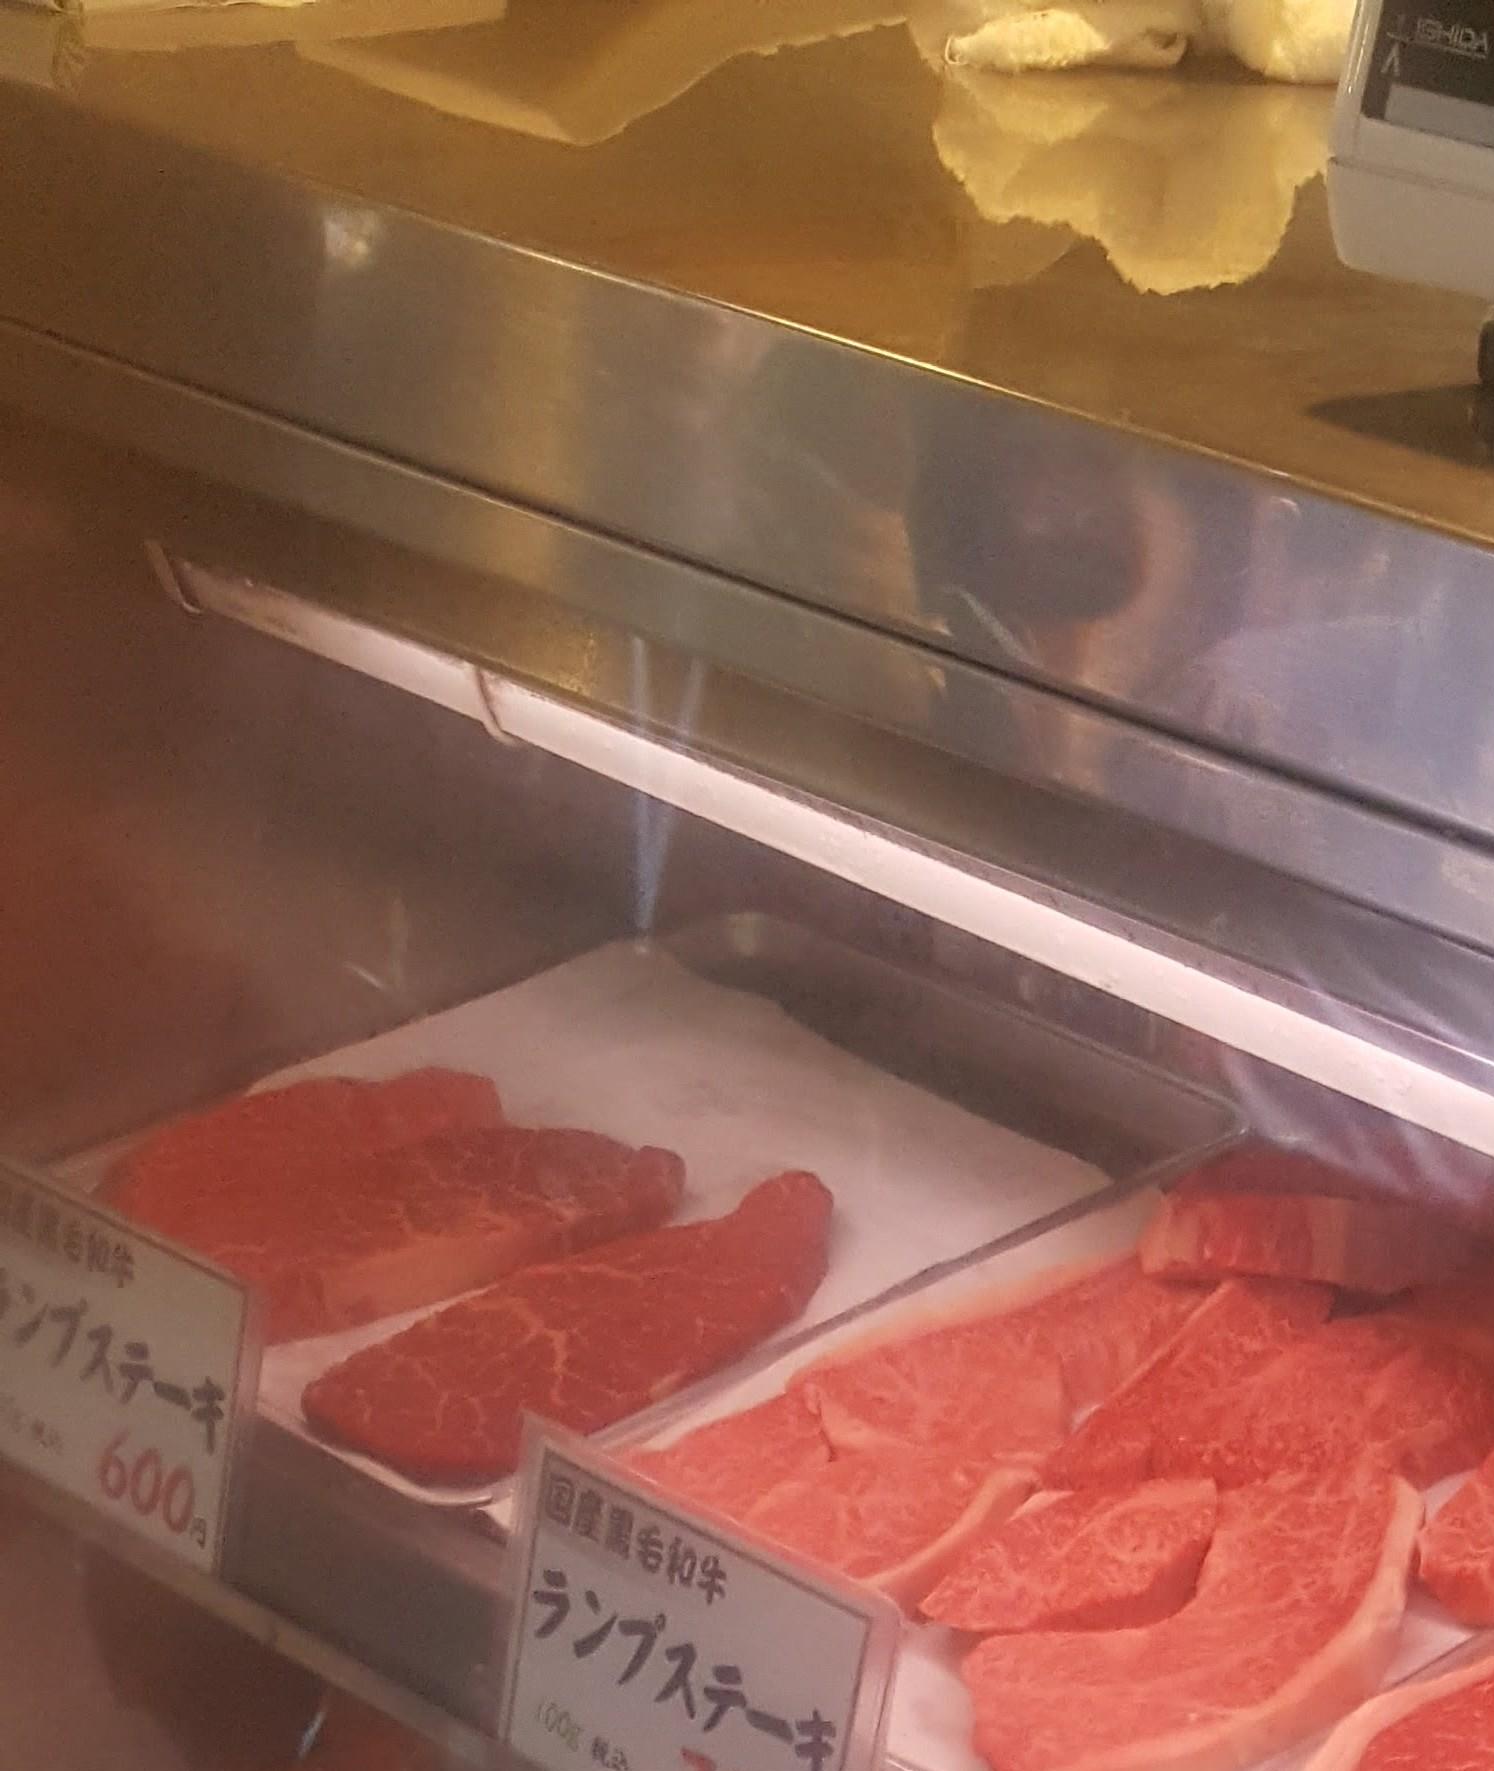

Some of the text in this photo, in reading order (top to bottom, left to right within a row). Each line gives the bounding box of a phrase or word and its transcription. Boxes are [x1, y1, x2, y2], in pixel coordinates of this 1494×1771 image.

[0, 1266, 225, 1456] ンプステーキ
[543, 1474, 727, 1605] 国産黒毛和牛
